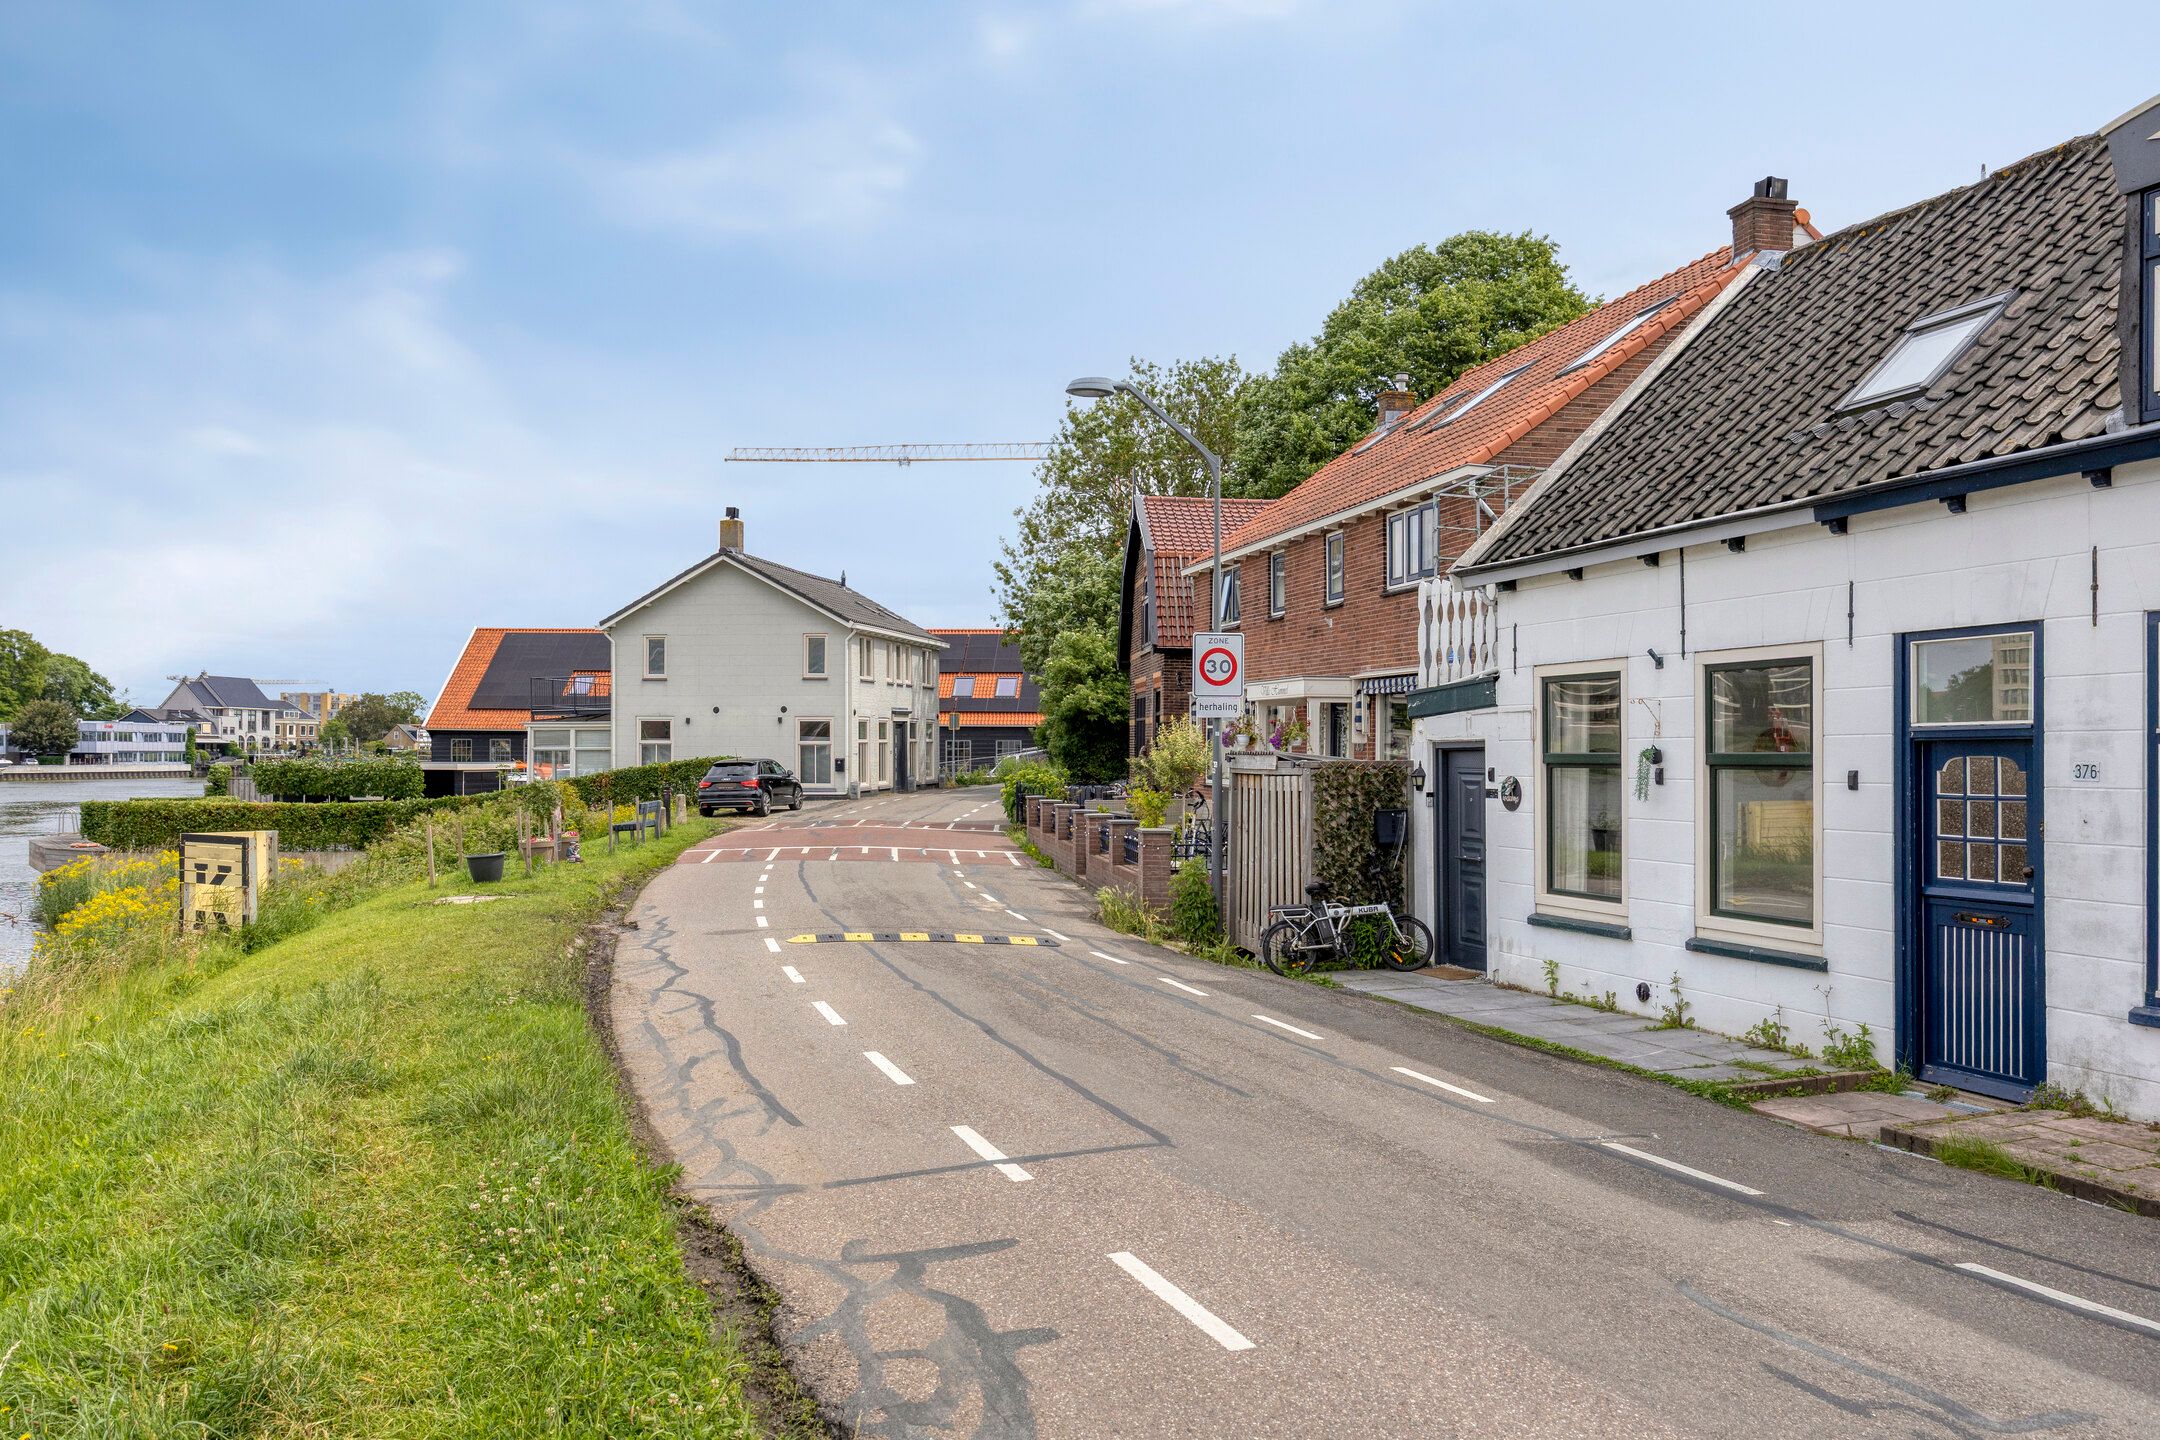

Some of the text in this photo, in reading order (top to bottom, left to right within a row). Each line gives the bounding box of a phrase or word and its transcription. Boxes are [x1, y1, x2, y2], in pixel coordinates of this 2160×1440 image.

[1208, 637, 1230, 645] ZONE
[1206, 659, 1232, 674] 30
[1199, 702, 1238, 713] herhaling
[2074, 763, 2098, 779] 376
[1358, 905, 1379, 914] KUBA
